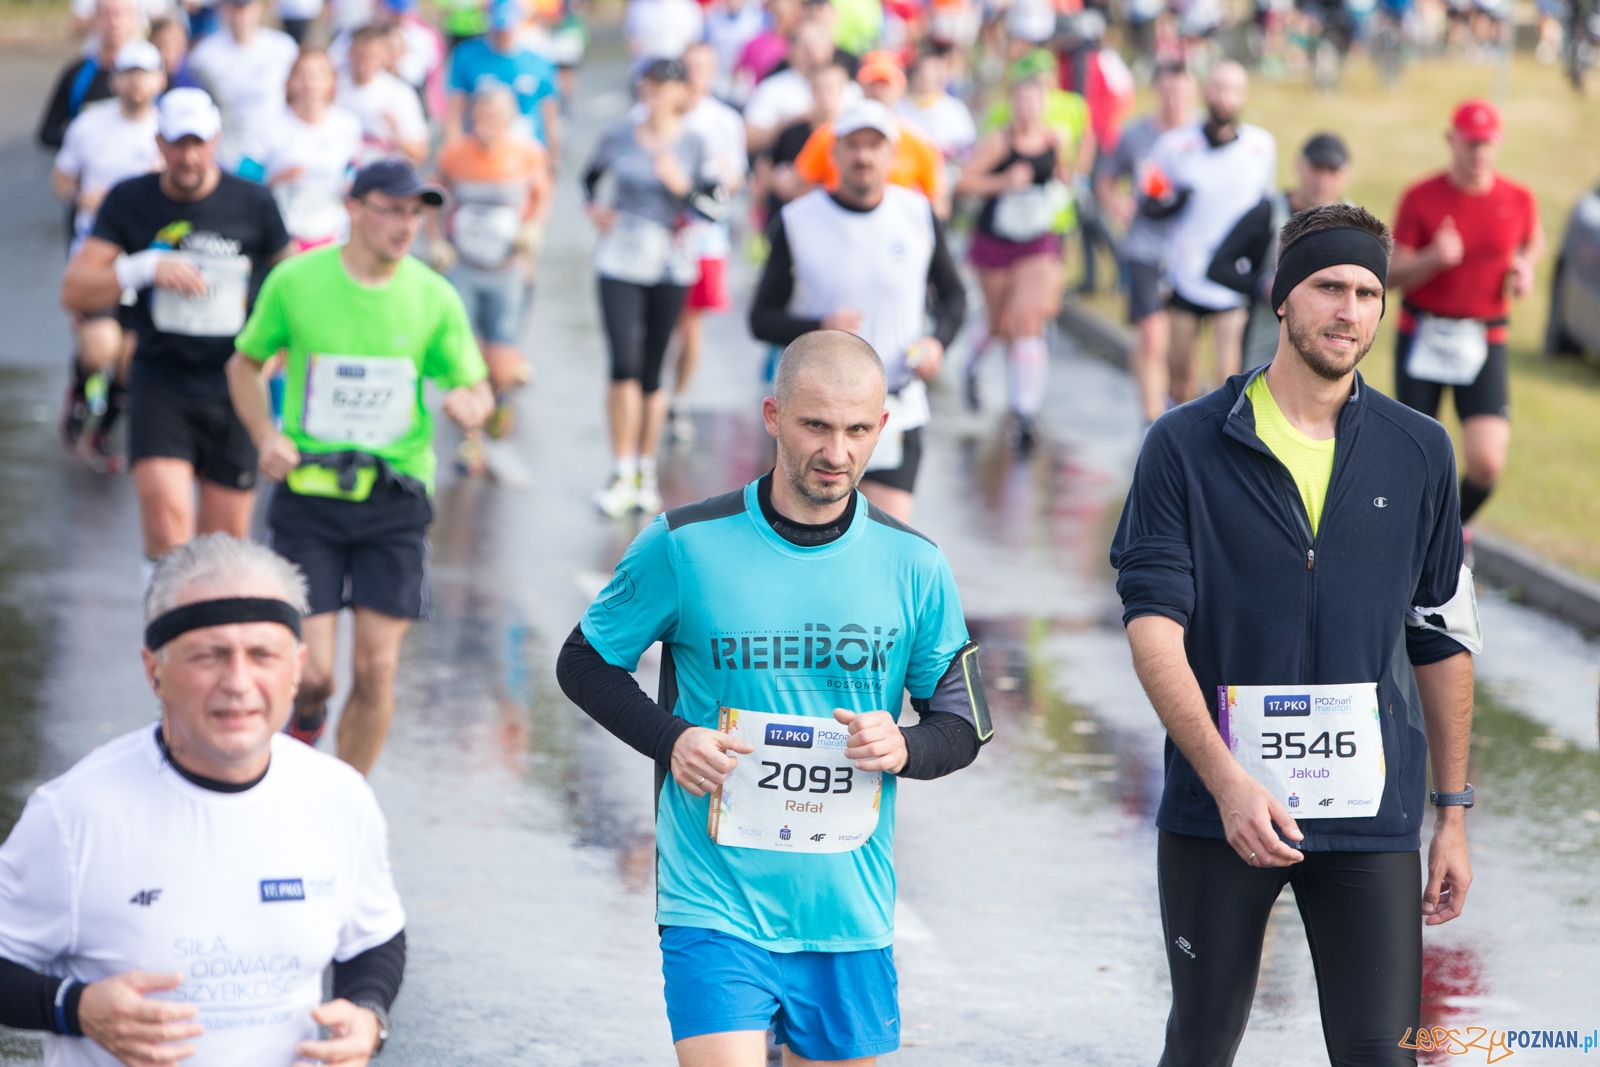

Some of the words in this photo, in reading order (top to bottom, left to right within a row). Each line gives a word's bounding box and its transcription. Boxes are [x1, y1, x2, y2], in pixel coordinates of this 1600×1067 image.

[710, 622, 899, 672] REEBOK
[1314, 704, 1352, 712] maraton
[817, 730, 850, 741] POZna
[1261, 731, 1357, 759] 3546
[757, 760, 853, 794] 2093
[1288, 767, 1330, 779] Jakub
[785, 799, 824, 814] Rafał
[1318, 798, 1334, 807] 4F
[810, 833, 827, 842] 4F
[129, 889, 162, 906] 4F
[173, 936, 227, 958] SIŁA
[190, 954, 300, 980] ODWAGA
